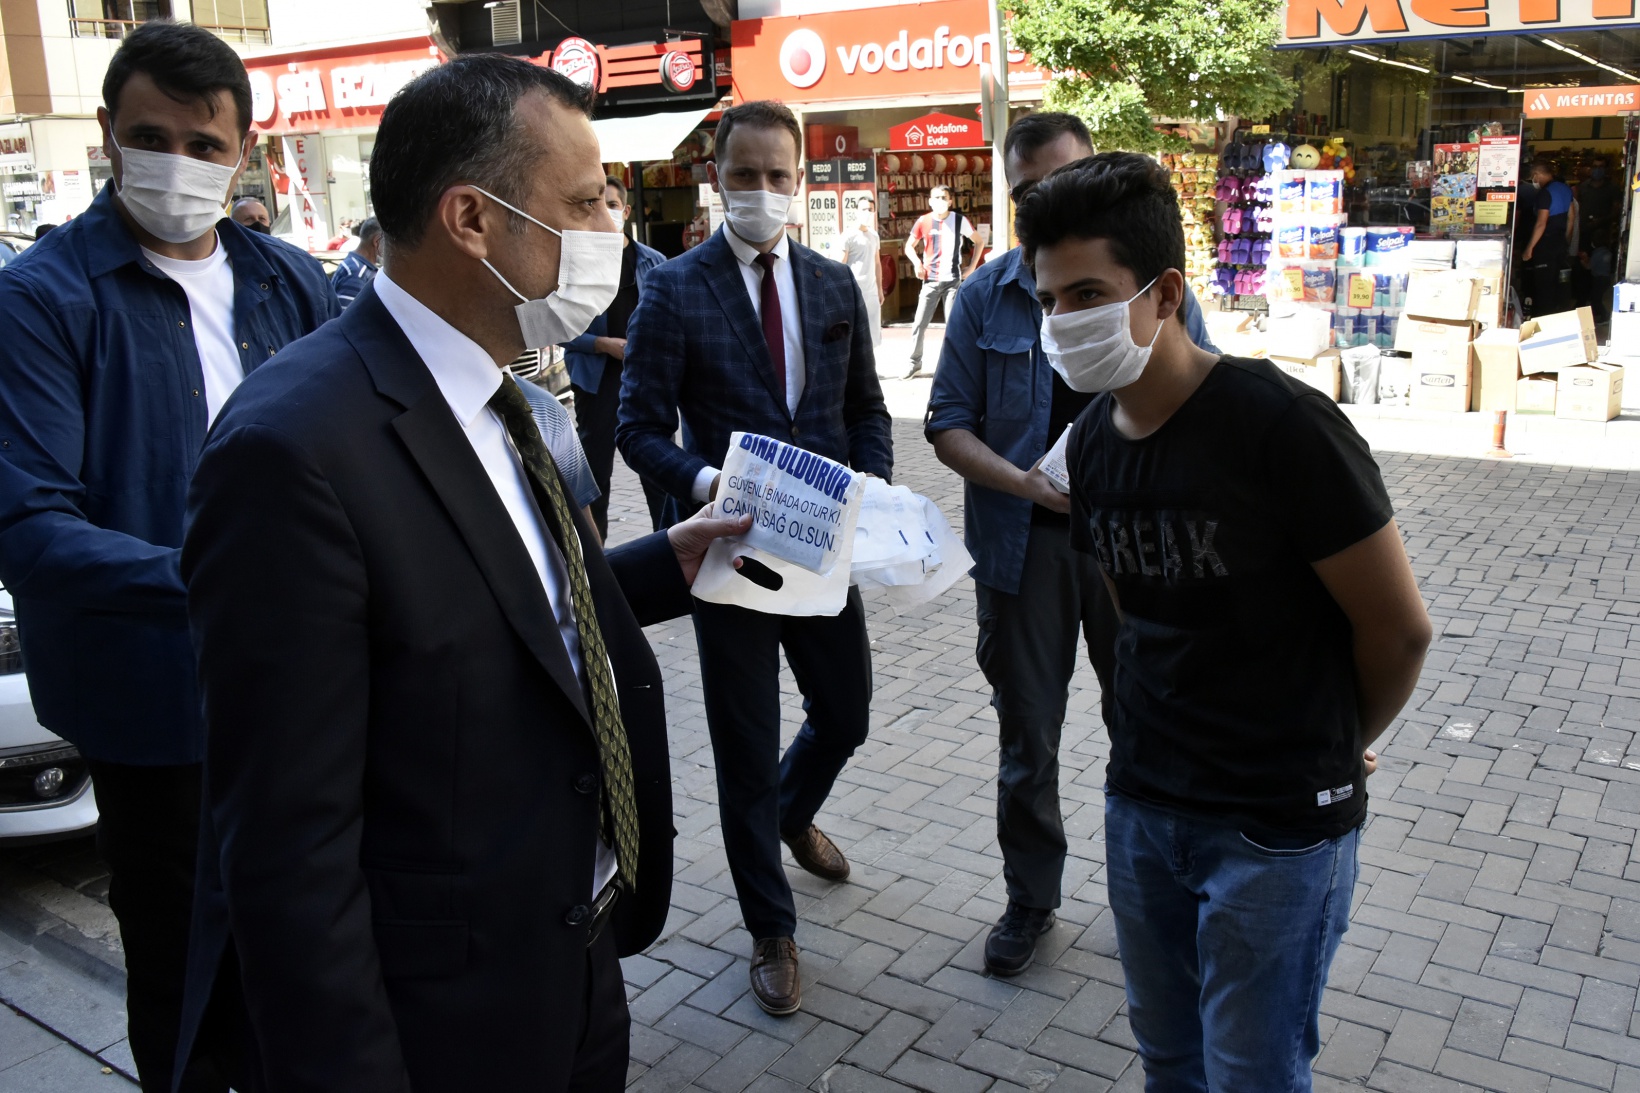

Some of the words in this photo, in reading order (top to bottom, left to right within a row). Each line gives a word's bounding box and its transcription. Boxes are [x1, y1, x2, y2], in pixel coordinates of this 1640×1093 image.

[926, 123, 968, 134] Vodafone
[927, 136, 949, 146] Evde
[812, 164, 832, 173] RED20
[847, 163, 867, 172] RED25
[810, 198, 822, 209] 20
[824, 198, 837, 209] GB
[1376, 234, 1406, 249] Selpak
[728, 474, 768, 498] GÜVENLİ
[766, 487, 801, 511] BİNADA
[722, 497, 761, 524] CANIN
[763, 510, 787, 534] SAĞ
[788, 520, 836, 552] OLSUN.
[1089, 518, 1230, 580] BREAK
